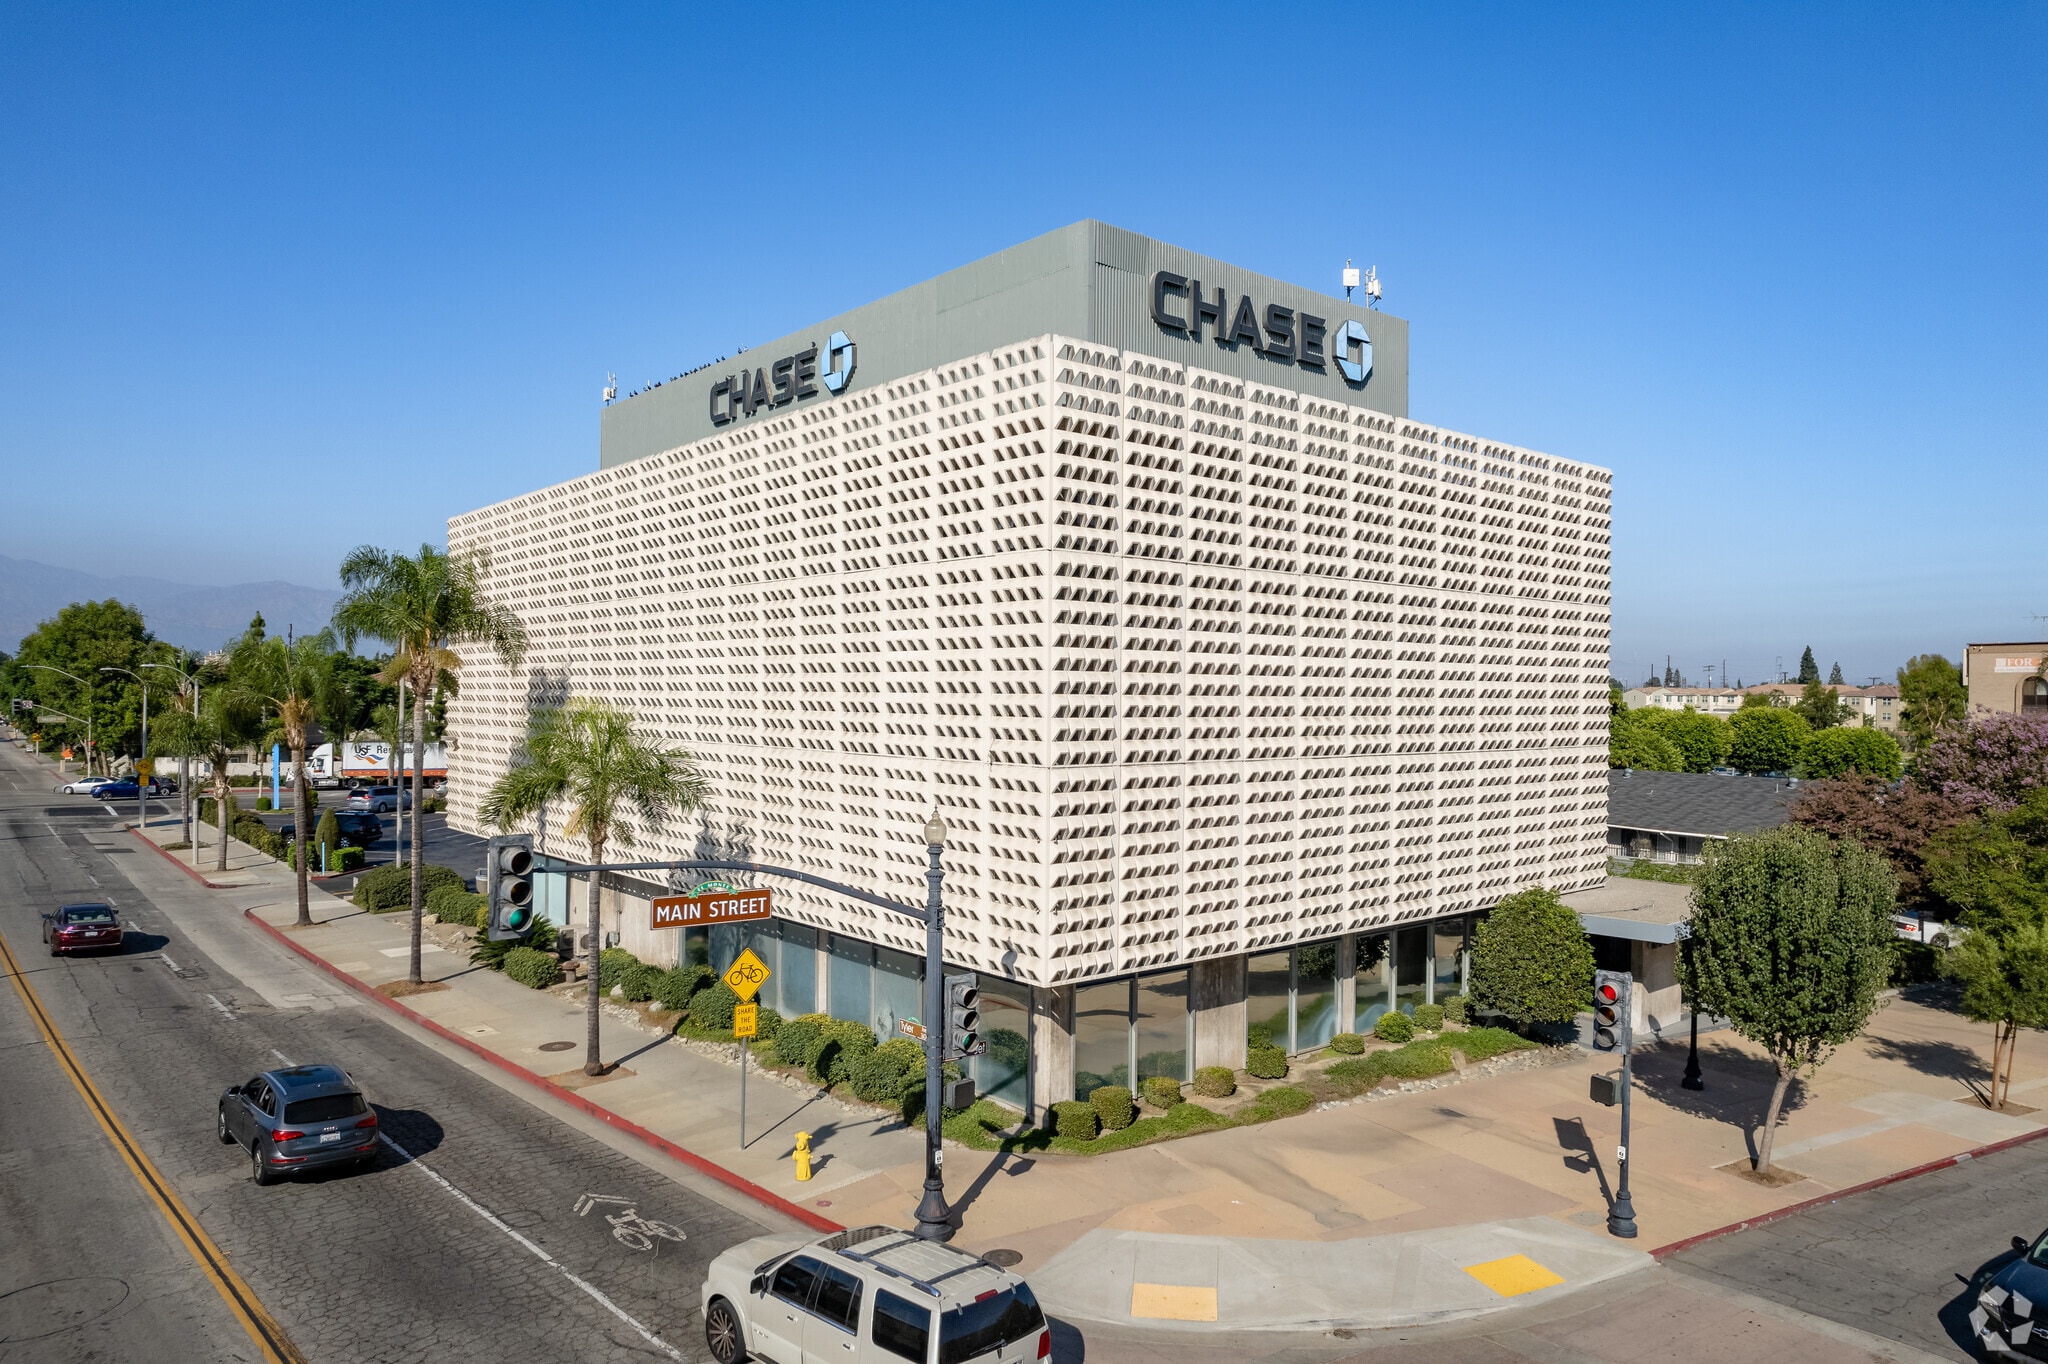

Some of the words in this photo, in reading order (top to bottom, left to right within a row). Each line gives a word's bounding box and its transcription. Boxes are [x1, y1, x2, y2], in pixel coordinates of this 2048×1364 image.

[1150, 270, 1326, 367] CHASE
[710, 347, 819, 423] CHASE
[2008, 658, 2032, 666] FOR
[355, 745, 371, 756] USF
[656, 902, 701, 922] MAIN
[709, 897, 767, 918] STREET
[737, 1006, 755, 1015] SHARE
[900, 1021, 914, 1033] Tyler
